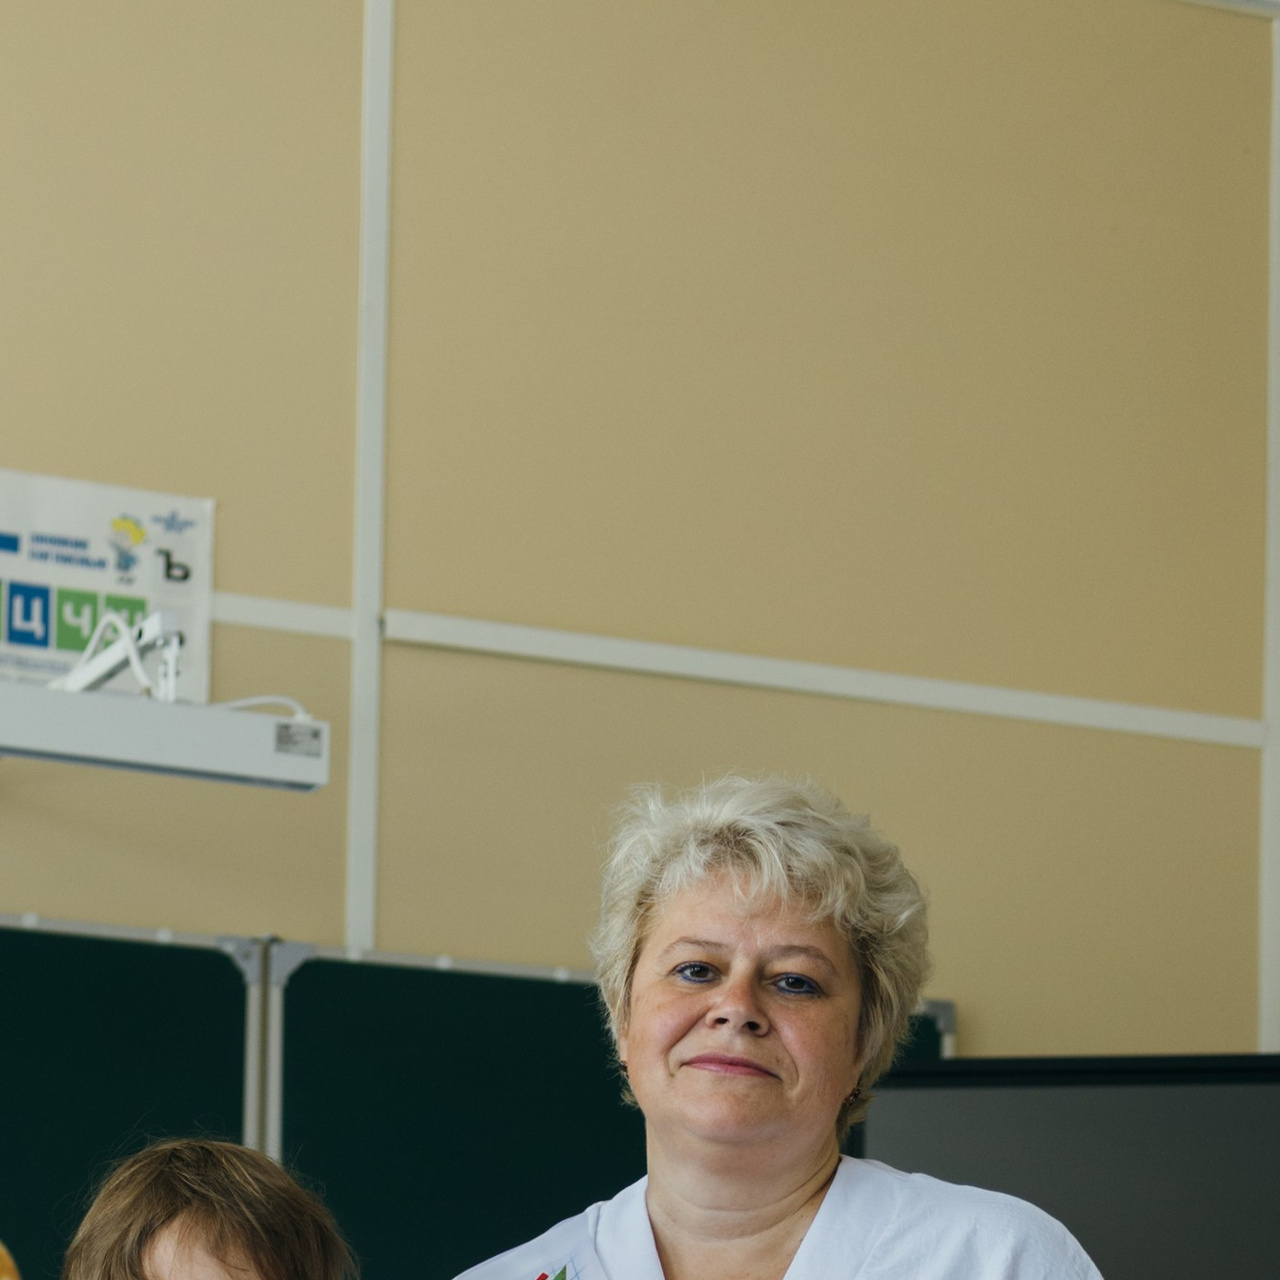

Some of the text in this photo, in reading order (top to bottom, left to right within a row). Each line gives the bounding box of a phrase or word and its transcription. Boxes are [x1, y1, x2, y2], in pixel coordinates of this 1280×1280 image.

[157, 549, 191, 582] Ъ
[12, 595, 47, 639] Ц
[61, 601, 93, 639] Ч
